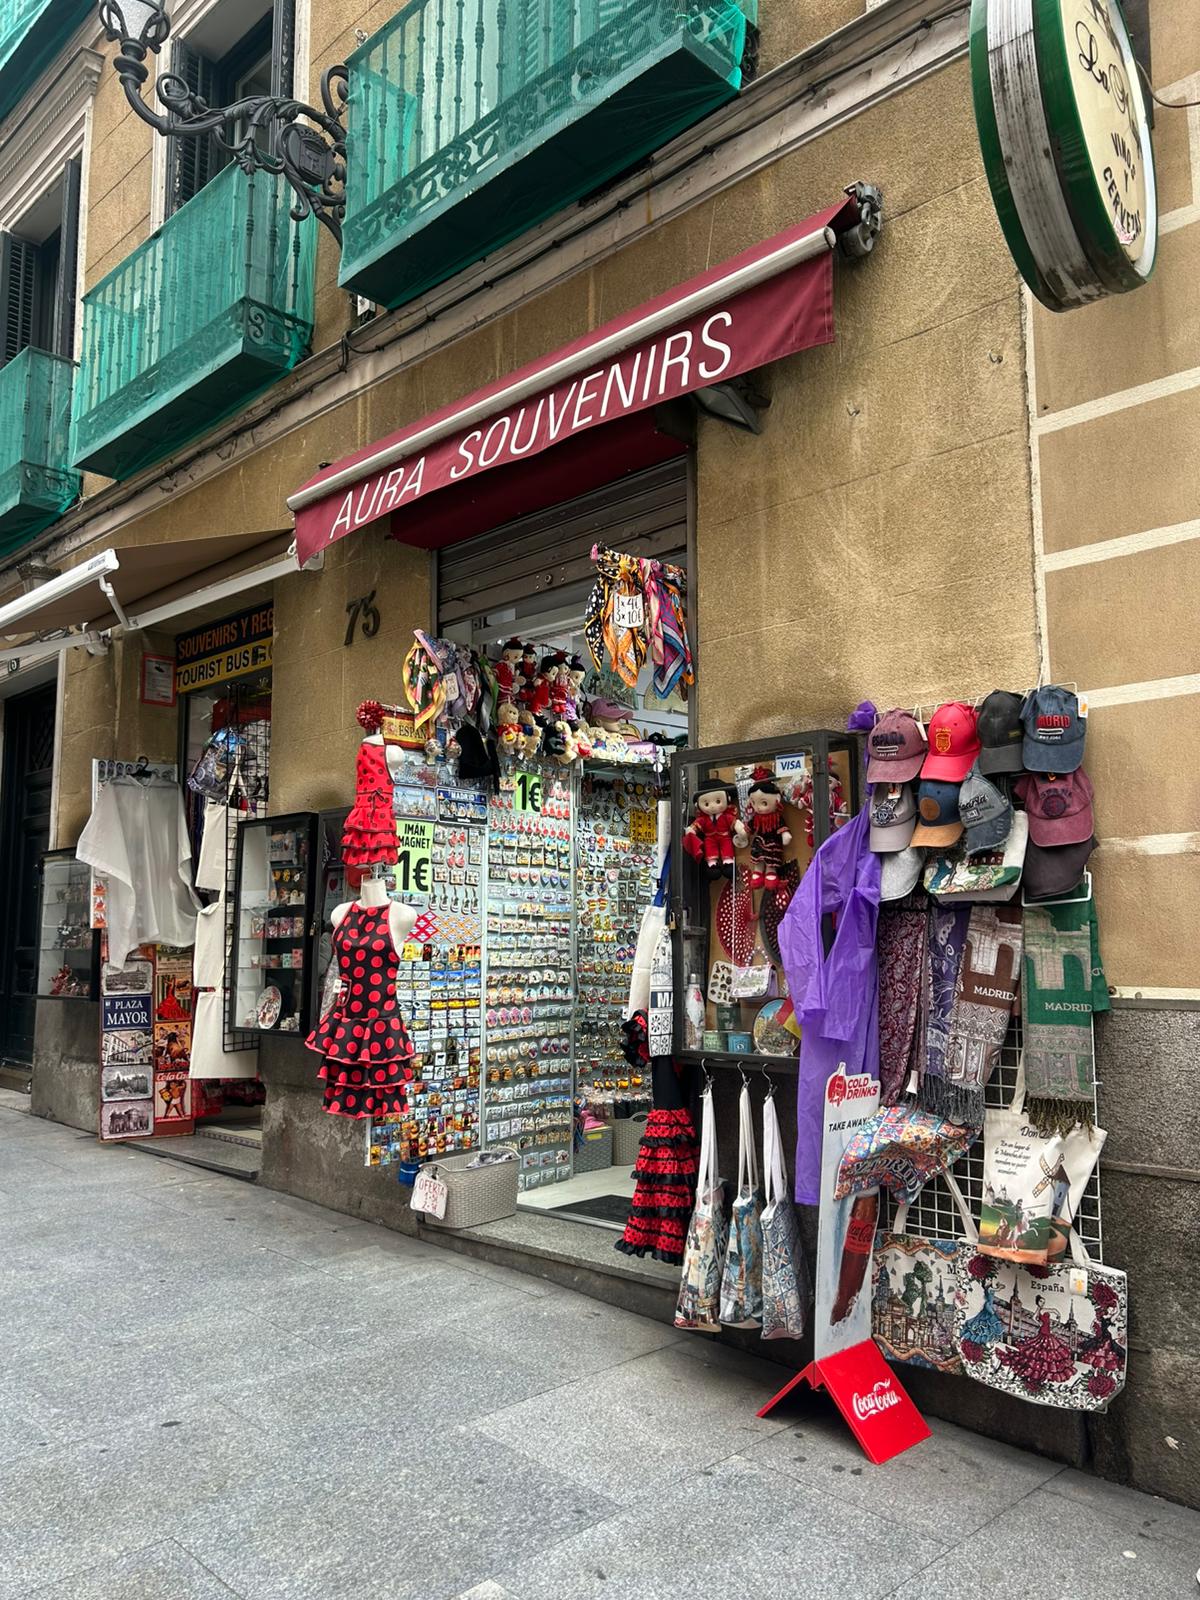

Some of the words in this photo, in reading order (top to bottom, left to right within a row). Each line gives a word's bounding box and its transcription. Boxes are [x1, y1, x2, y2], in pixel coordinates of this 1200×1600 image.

[329, 456, 426, 539] AURA
[450, 311, 732, 480] SOUVENIRS
[344, 590, 381, 646] 75
[178, 621, 238, 660] SOUVENIRS
[240, 617, 249, 639] Y
[176, 658, 222, 689] TOURIST
[226, 649, 250, 673] BUS
[780, 760, 802, 771] VISA
[516, 774, 541, 812] 1€
[404, 822, 426, 836] IMÁN
[398, 836, 430, 849] MAGNET
[398, 850, 429, 891] 1€
[974, 985, 1015, 1000] MADRID
[115, 1000, 143, 1010] PLAZA
[1044, 1002, 1092, 1013] MADRID
[106, 1011, 148, 1026] MAYOR
[847, 1077, 869, 1089] COLD
[846, 1085, 878, 1100] DRINKS
[828, 1121, 846, 1132] TAKE
[418, 1178, 445, 1198] OFERTA
[1031, 1281, 1064, 1293] España
